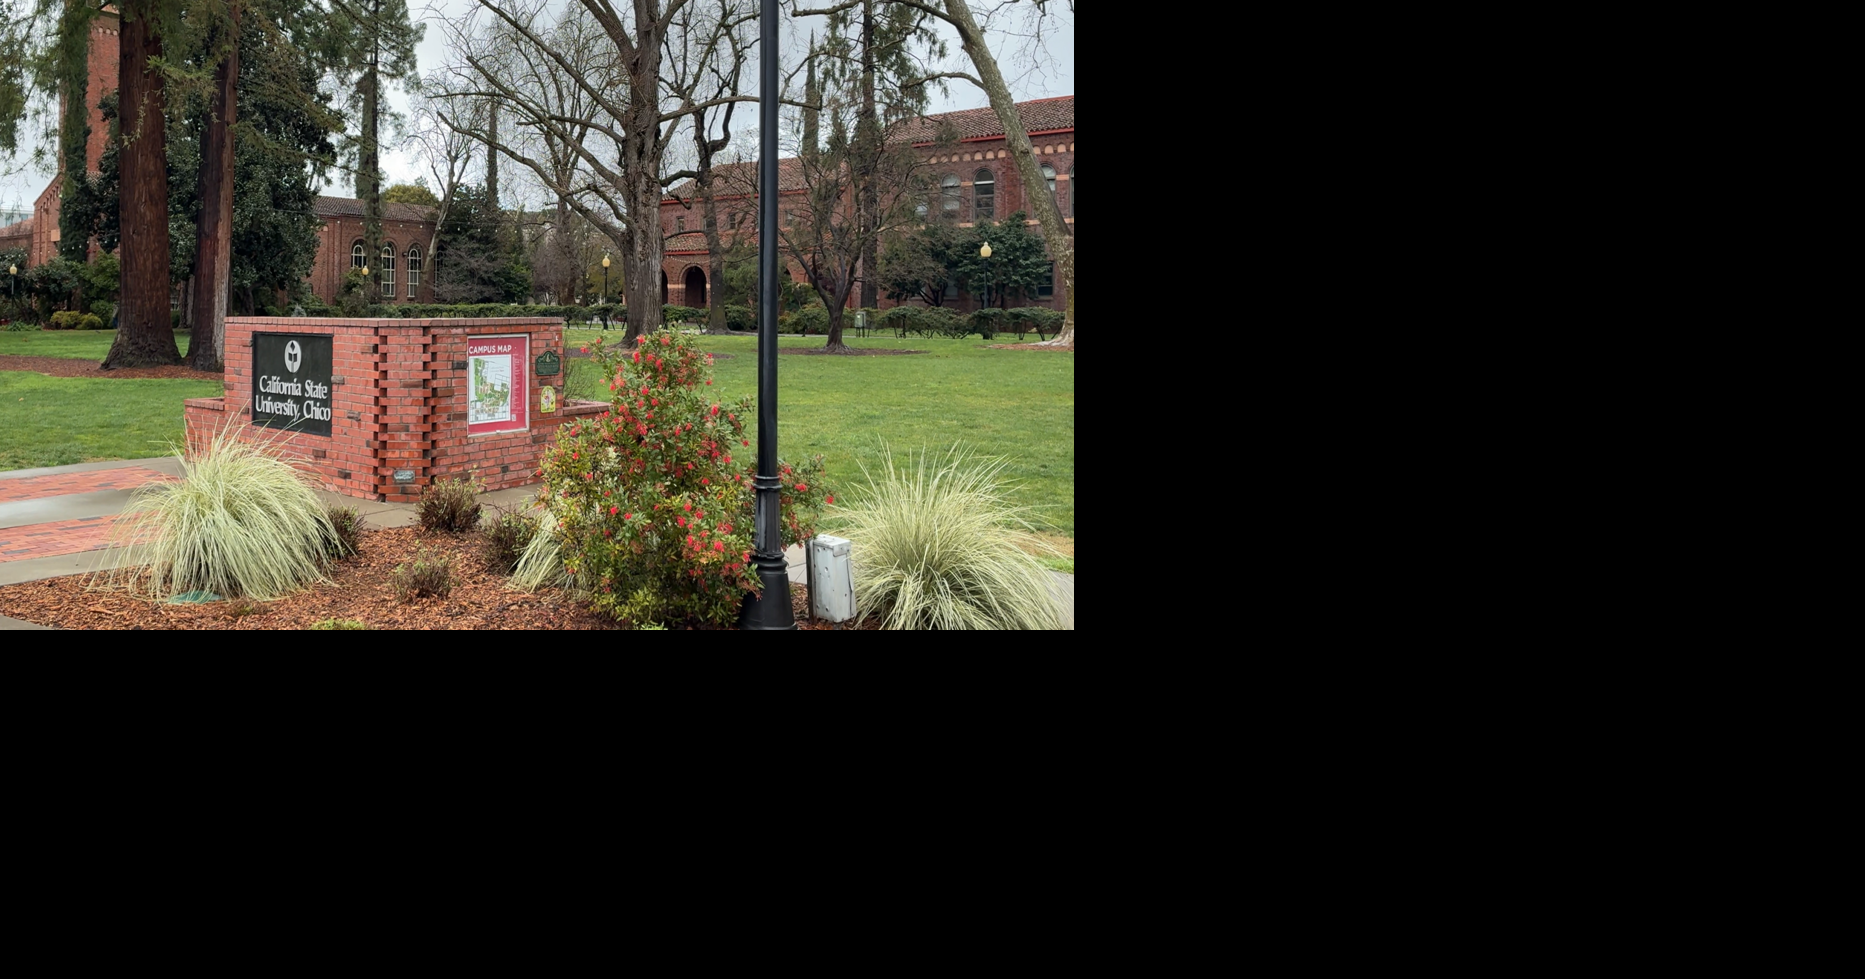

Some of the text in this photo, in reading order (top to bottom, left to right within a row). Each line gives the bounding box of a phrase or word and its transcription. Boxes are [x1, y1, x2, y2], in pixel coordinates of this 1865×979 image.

[468, 344, 512, 354] CAMPUS MAP
[259, 375, 328, 399] California State
[255, 395, 331, 421] University, Chico
